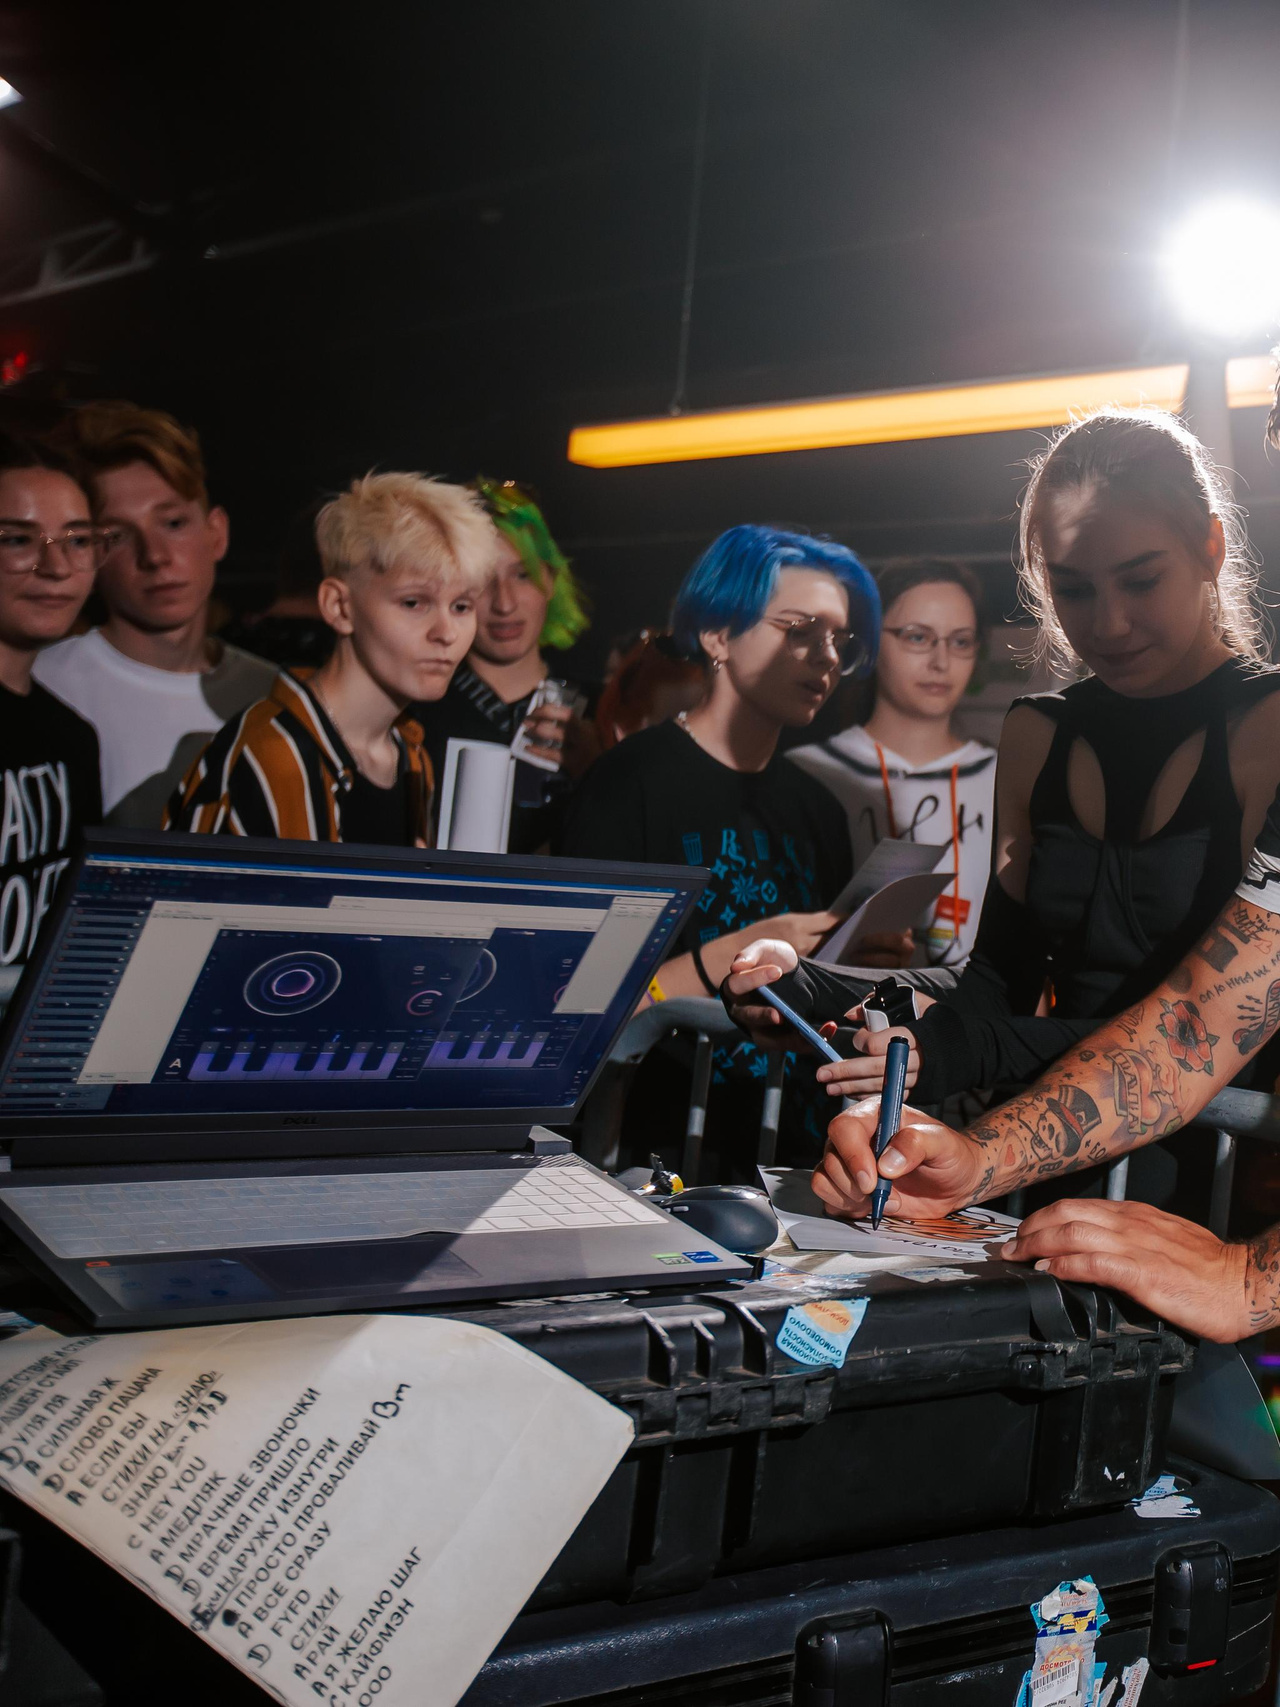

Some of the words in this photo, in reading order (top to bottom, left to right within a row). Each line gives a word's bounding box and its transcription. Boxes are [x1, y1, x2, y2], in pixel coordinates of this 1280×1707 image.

[0, 761, 71, 864] ASTY
[788, 1316, 842, 1357] DOMODEDOVO
[0, 1388, 43, 1433] АШЕН
[37, 1388, 105, 1458] СИЛЬНАЯ
[59, 1415, 114, 1473] СЛОВО
[109, 1367, 163, 1415] ПАЦАНА
[79, 1440, 124, 1489] ЕСЛИ
[120, 1411, 150, 1441] БЫ
[100, 1443, 153, 1504] СТИХИ
[149, 1419, 174, 1446] НА
[120, 1465, 168, 1518] ЗНАЮ
[140, 1494, 174, 1534] HEY
[171, 1456, 206, 1493] YOU
[178, 1473, 254, 1564] МРАЧНЫЕ
[249, 1387, 322, 1474] ЗВОНОЧКИ
[160, 1470, 227, 1549] МЕДЛЯК
[197, 1512, 254, 1579] ВРЕМЯ
[248, 1437, 311, 1515] ПРИШЛО
[216, 1513, 280, 1594] НАРУЖУ
[276, 1437, 341, 1516] ИЗНУТРИ
[234, 1531, 297, 1608] ПРОСТО
[293, 1418, 381, 1533] ПРОВАЛИВАЙ
[252, 1581, 289, 1623] ВСЕ
[284, 1520, 333, 1582] СРАЗУ
[270, 1589, 311, 1638] FYFD
[290, 1586, 341, 1652] СТИХИ
[305, 1623, 341, 1667] РАЙ
[323, 1663, 340, 1682] Я
[335, 1589, 393, 1665] ЖЕЛАЮ
[389, 1546, 423, 1590] ШАГ
[339, 1597, 414, 1696] КАЙФМЭН
